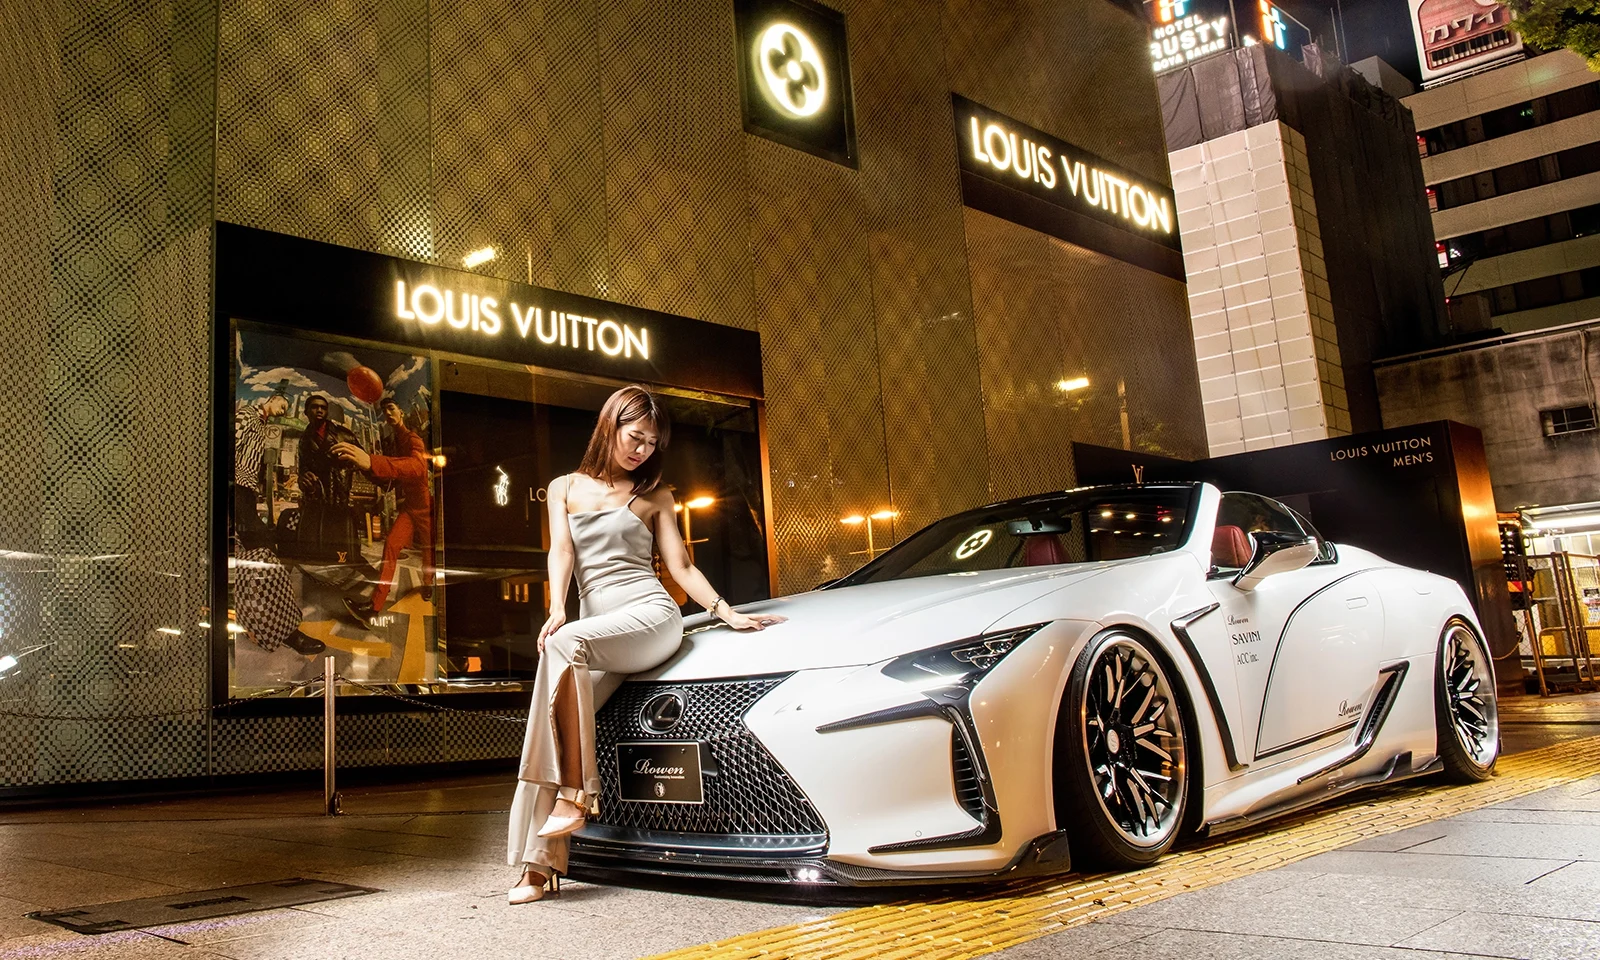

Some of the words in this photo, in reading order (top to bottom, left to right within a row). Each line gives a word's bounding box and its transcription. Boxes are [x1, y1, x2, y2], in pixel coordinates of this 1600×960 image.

[1154, 14, 1203, 39] HOTEL
[1425, 4, 1500, 43] カワイ
[970, 116, 1056, 189] LOUIS
[1060, 155, 1170, 234] VUITTON
[396, 280, 501, 335] LOUIS
[511, 302, 649, 360] VUITTON
[1330, 446, 1368, 462] LOUIS
[1372, 436, 1431, 454] VUITTON
[1393, 451, 1434, 468] MEN'S
[1231, 630, 1261, 646] SAVINI
[632, 758, 685, 774] Rowen
